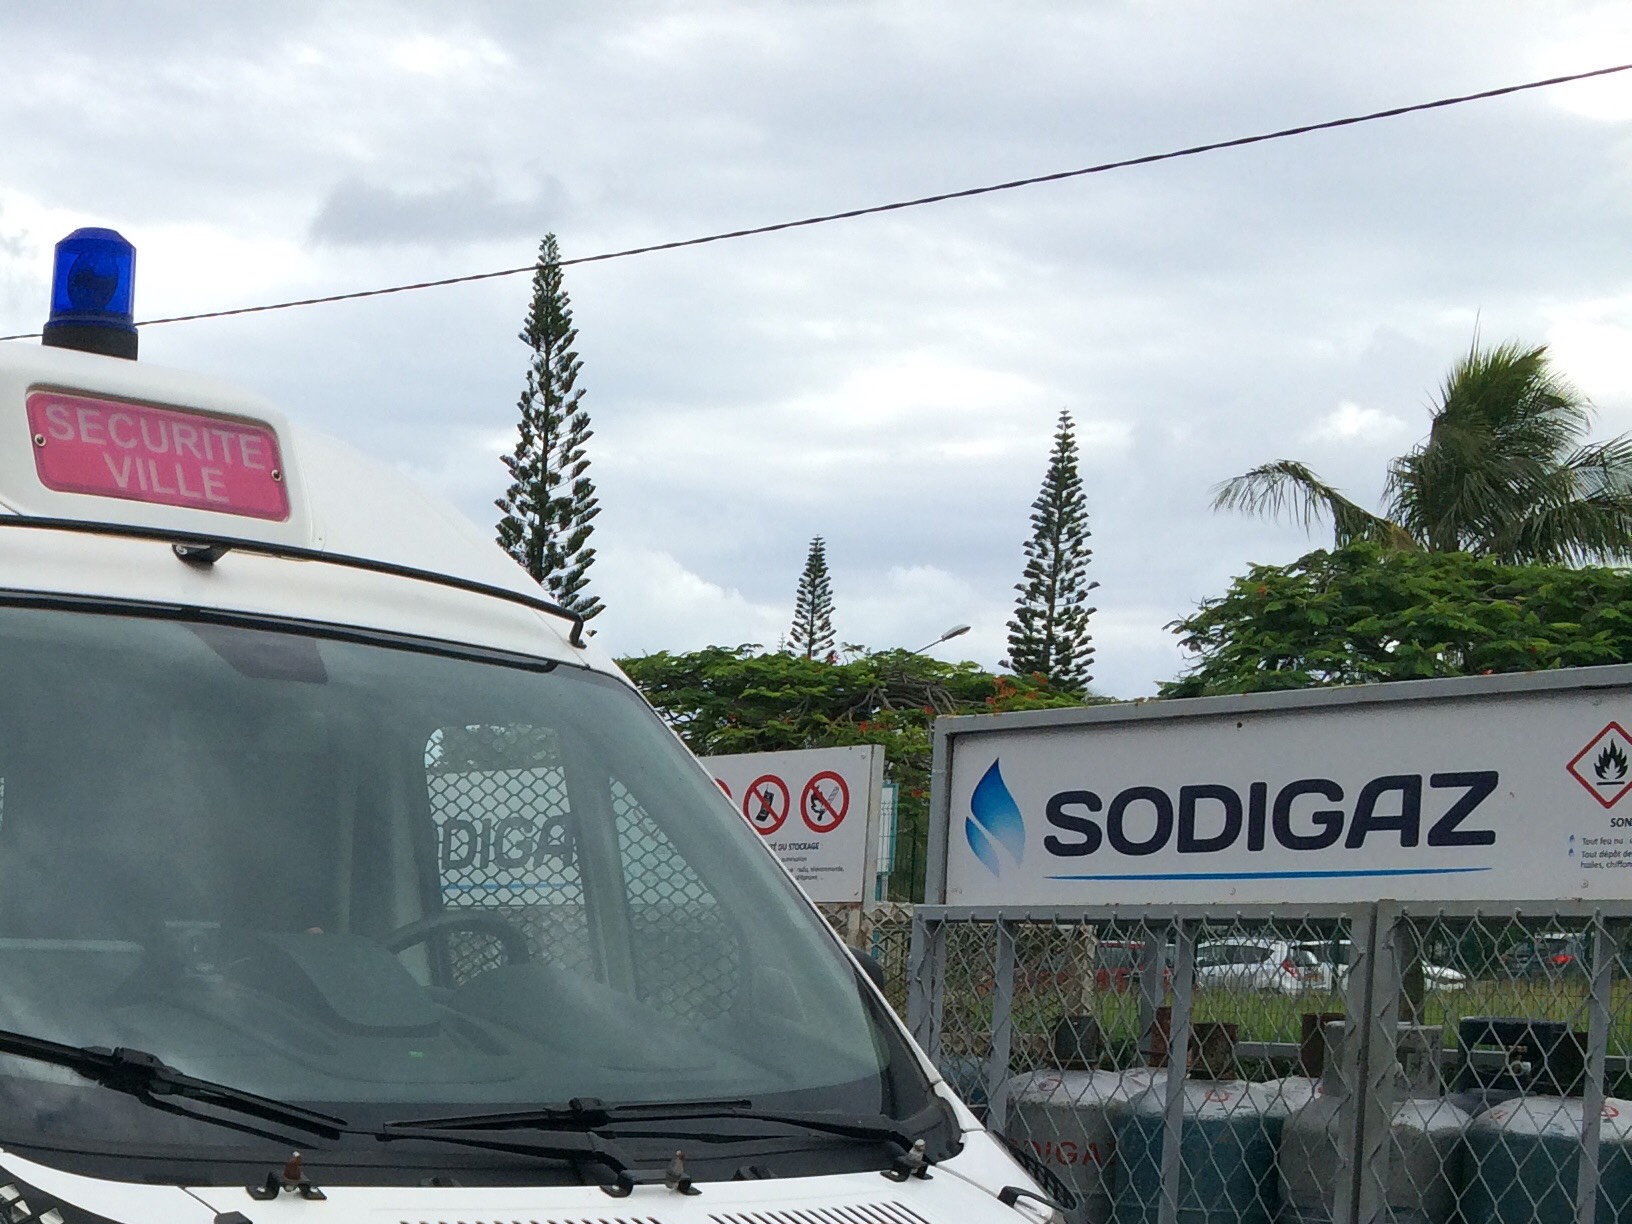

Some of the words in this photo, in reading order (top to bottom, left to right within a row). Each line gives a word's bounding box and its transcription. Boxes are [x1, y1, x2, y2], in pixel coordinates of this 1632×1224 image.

[45, 404, 265, 470] SECURITE
[103, 451, 230, 502] VILLE
[1043, 770, 1499, 858] SODIGAZ
